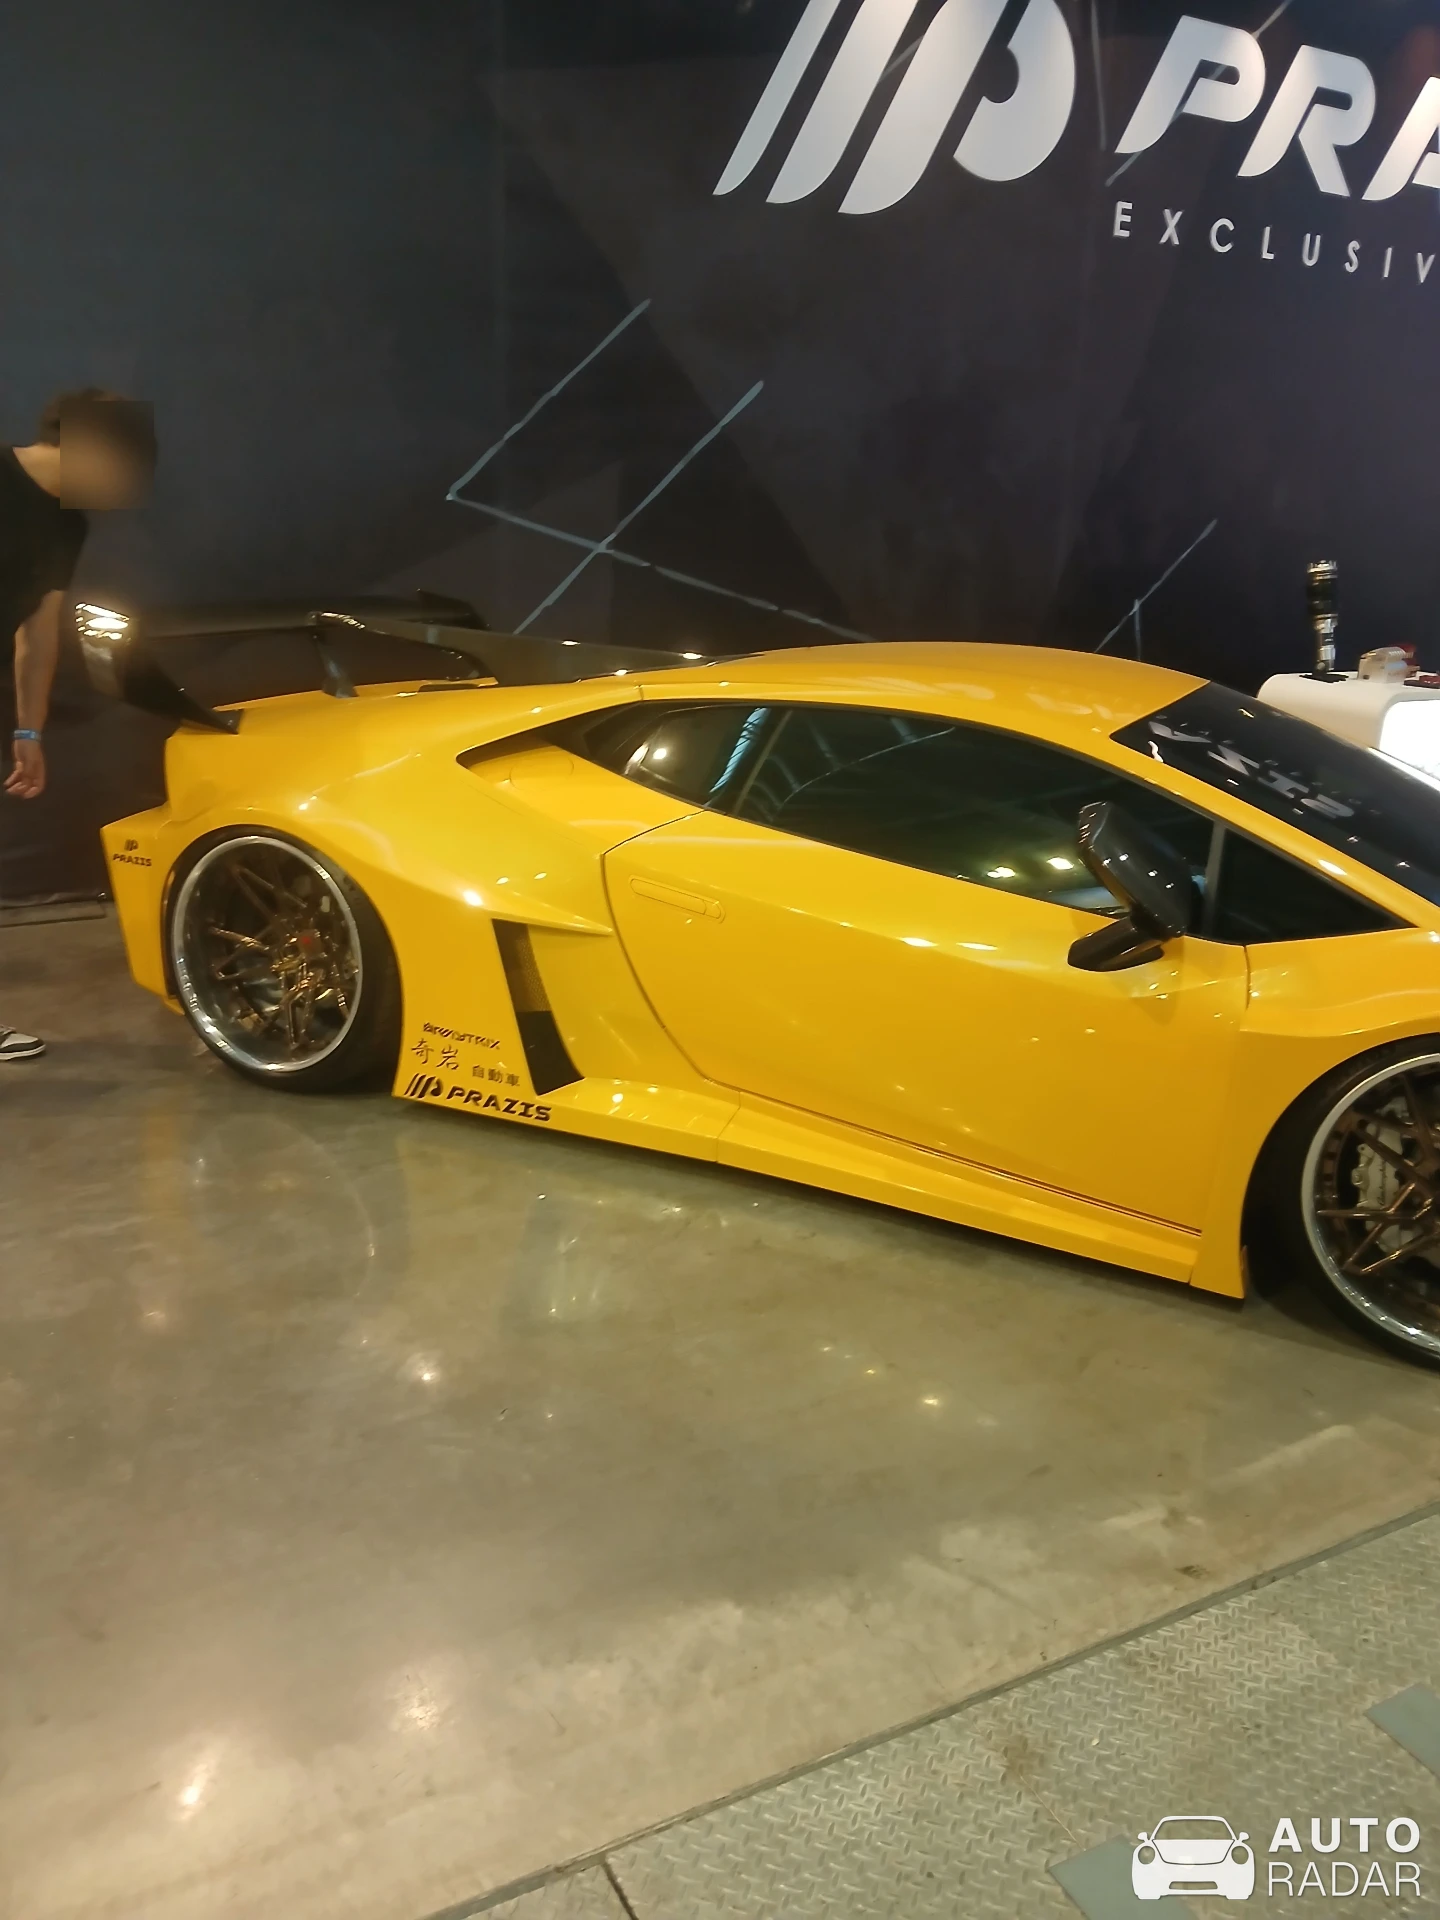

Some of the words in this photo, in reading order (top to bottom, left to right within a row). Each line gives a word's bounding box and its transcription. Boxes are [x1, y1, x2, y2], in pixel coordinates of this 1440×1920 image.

[1113, 201, 1436, 284] EXCLUSIV
[112, 853, 152, 866] PRAZIS
[411, 1038, 459, 1070] 奇岩
[471, 1065, 520, 1086] 自動車
[446, 1085, 552, 1122] PRAZIS
